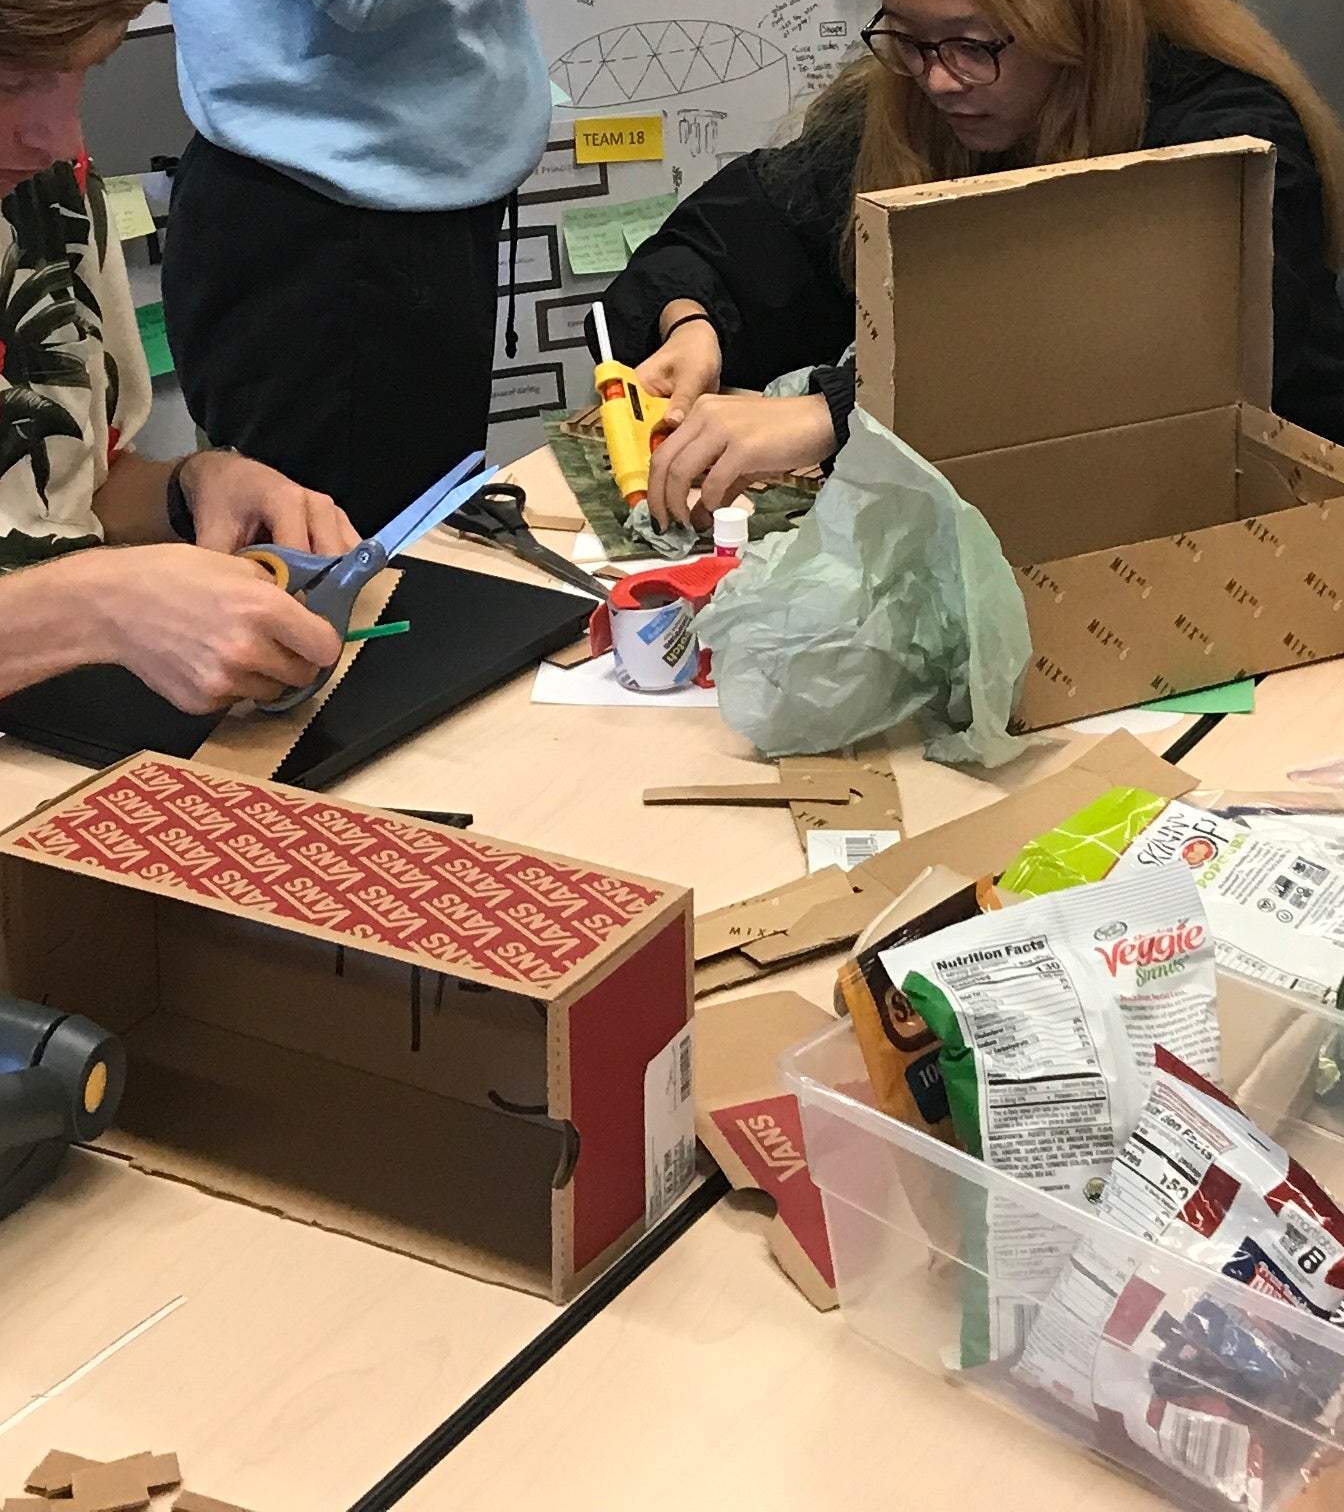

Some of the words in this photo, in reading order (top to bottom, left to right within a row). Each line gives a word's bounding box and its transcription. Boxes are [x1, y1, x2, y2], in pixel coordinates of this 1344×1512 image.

[582, 130, 625, 149] TEAM
[626, 129, 646, 146] 18
[97, 788, 169, 834] VANS
[302, 809, 379, 855] VANS
[507, 867, 589, 919] VANS
[935, 948, 1003, 972] Nutrition
[1004, 938, 1046, 957] Facts
[1093, 921, 1206, 977] Veggie
[735, 1113, 807, 1182] VANS
